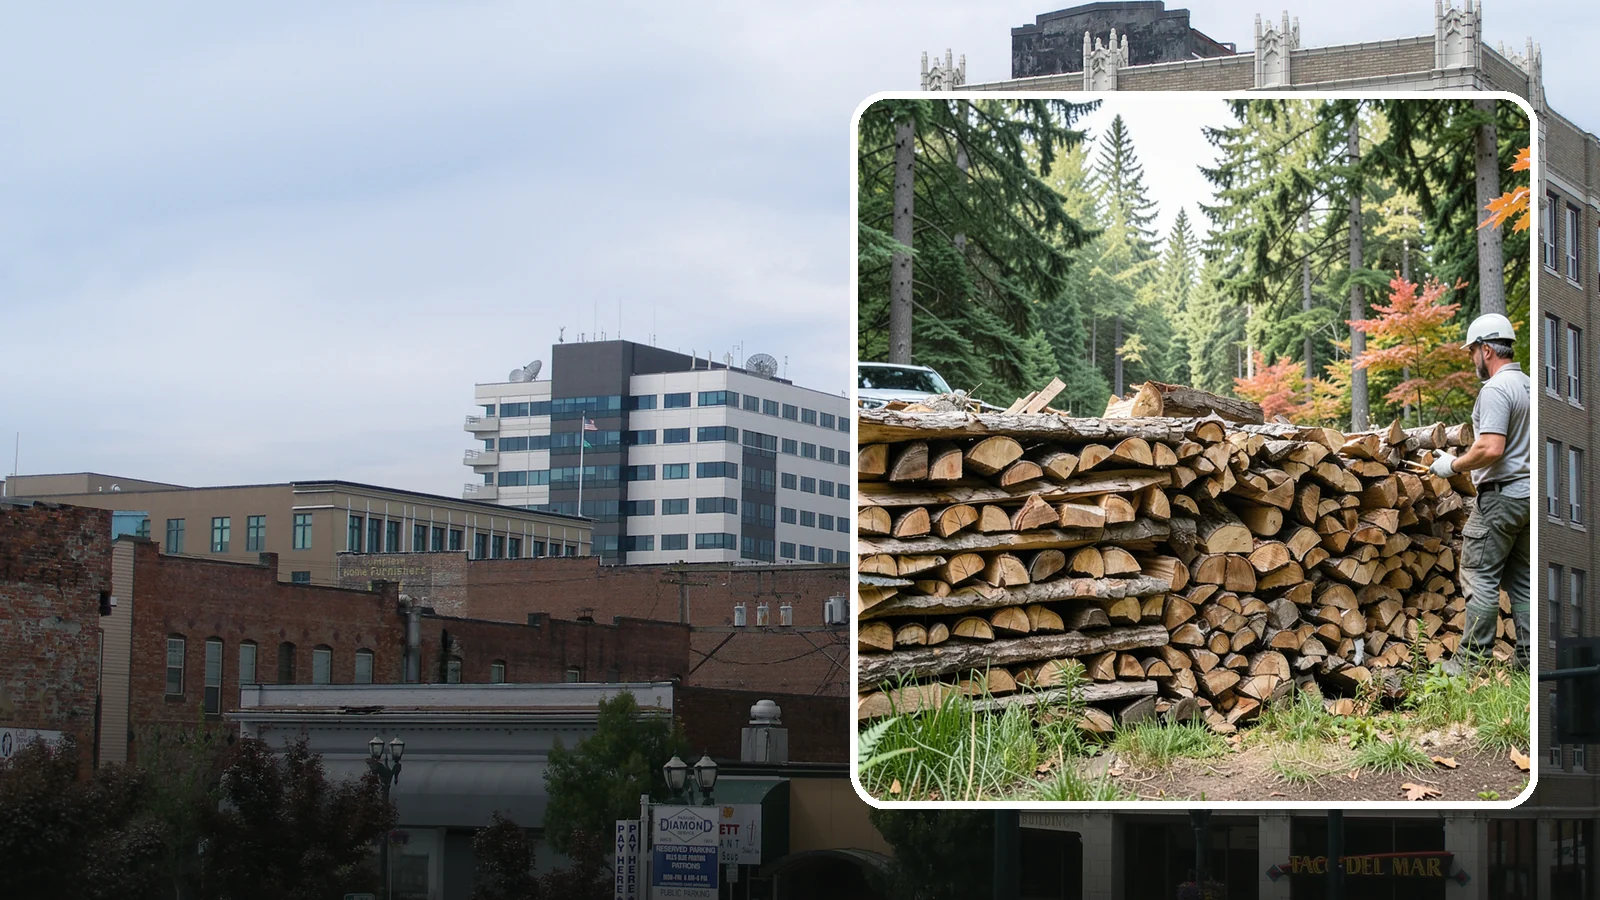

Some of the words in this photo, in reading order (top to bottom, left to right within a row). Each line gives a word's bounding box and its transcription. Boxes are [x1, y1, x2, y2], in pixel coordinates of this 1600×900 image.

[343, 568, 368, 577] Home
[370, 566, 426, 576] Furnishers
[660, 818, 713, 832] DIAMOND
[1022, 815, 1069, 827] BUILDING
[628, 824, 637, 853] PAY
[722, 852, 739, 862] Soup
[671, 862, 701, 870] PATRONS
[1289, 856, 1330, 874] TAC
[1346, 857, 1385, 875] DEL
[1393, 857, 1442, 876] MAR
[628, 855, 636, 893] HERE
[660, 889, 682, 897] PUBLIC
[684, 889, 710, 898] PARKING
